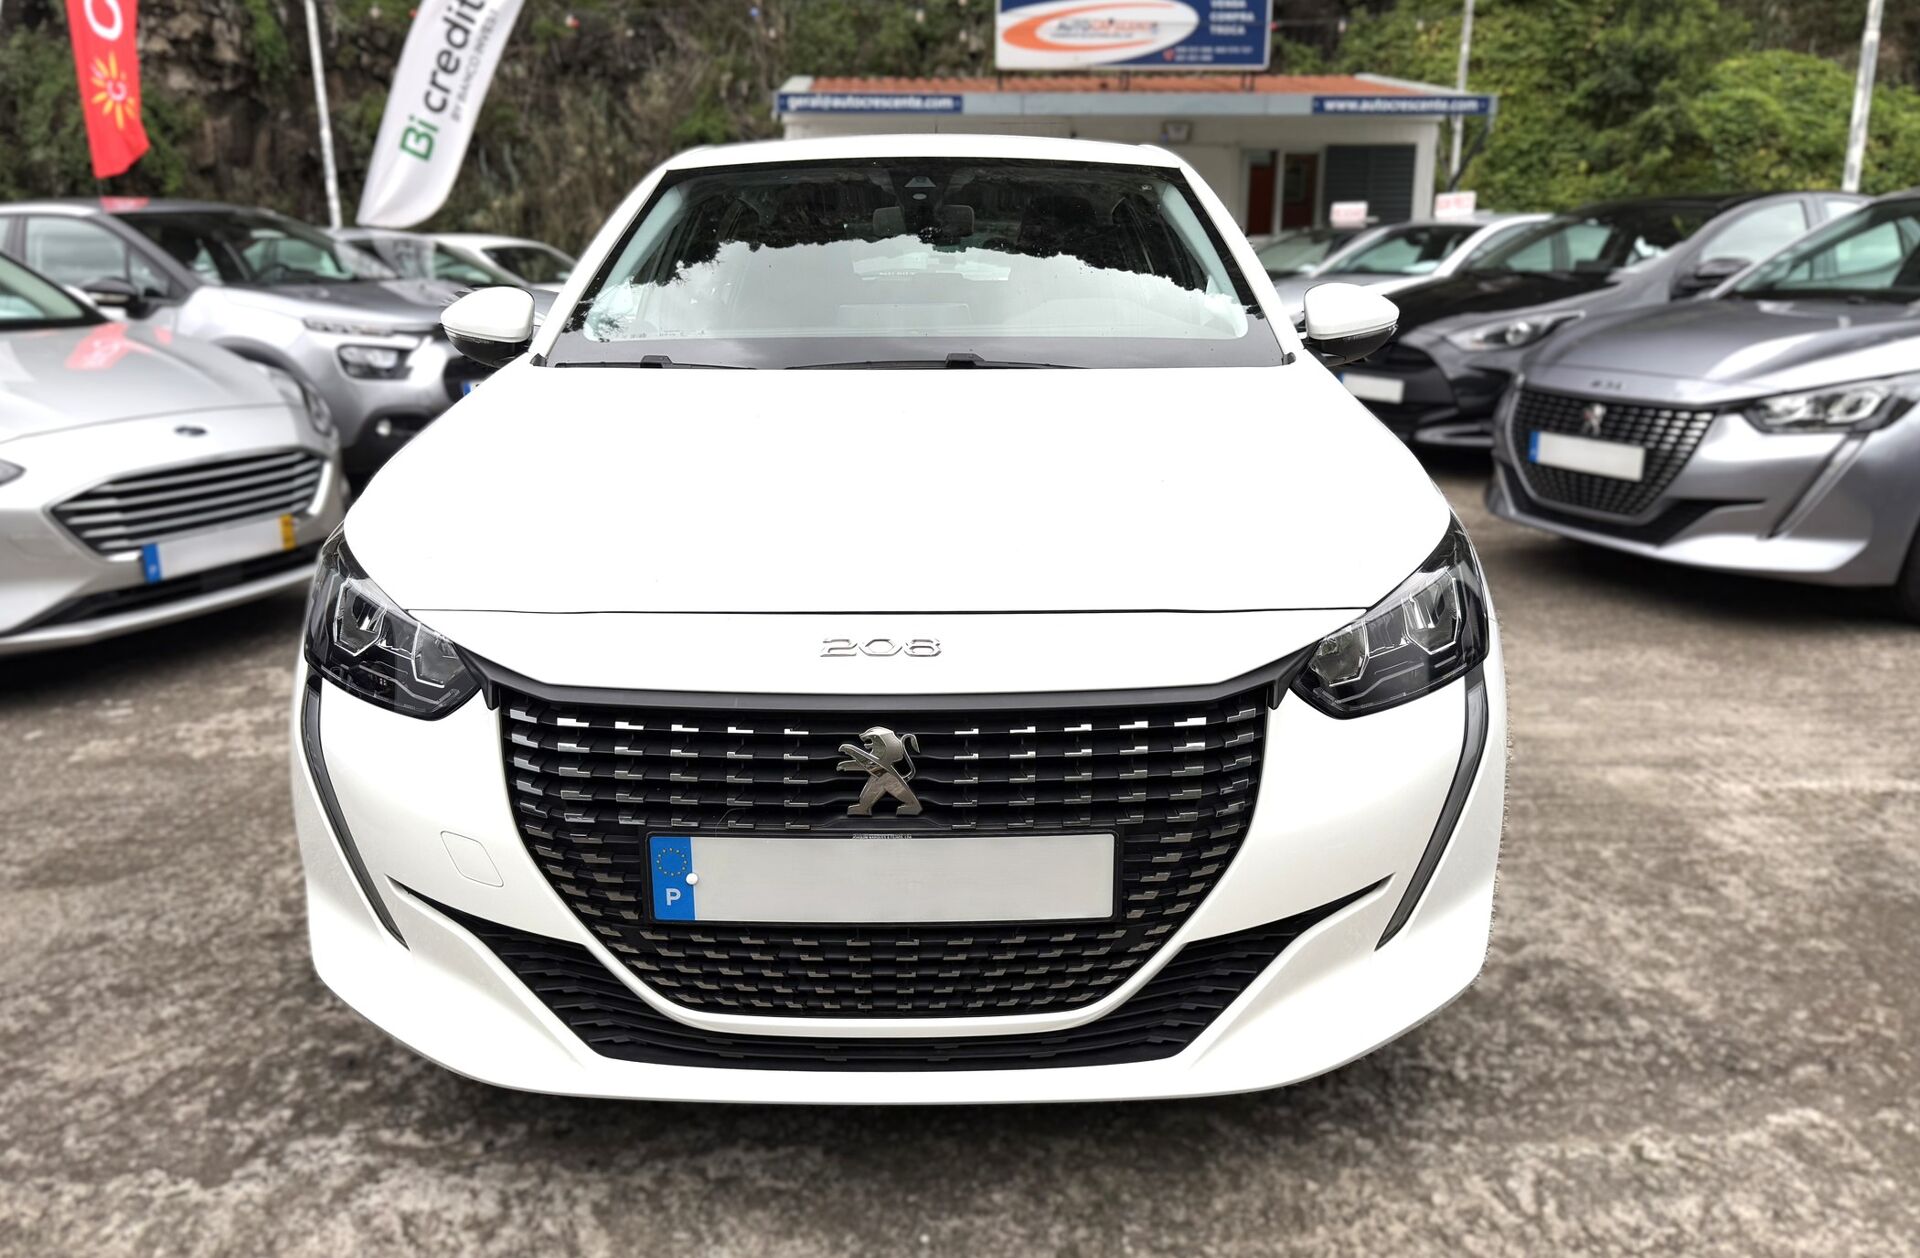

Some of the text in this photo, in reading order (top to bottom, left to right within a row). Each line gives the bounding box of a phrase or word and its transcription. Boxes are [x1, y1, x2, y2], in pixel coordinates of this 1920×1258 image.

[400, 0, 485, 161] Bi credit
[819, 638, 942, 657] 208
[665, 888, 681, 906] P
